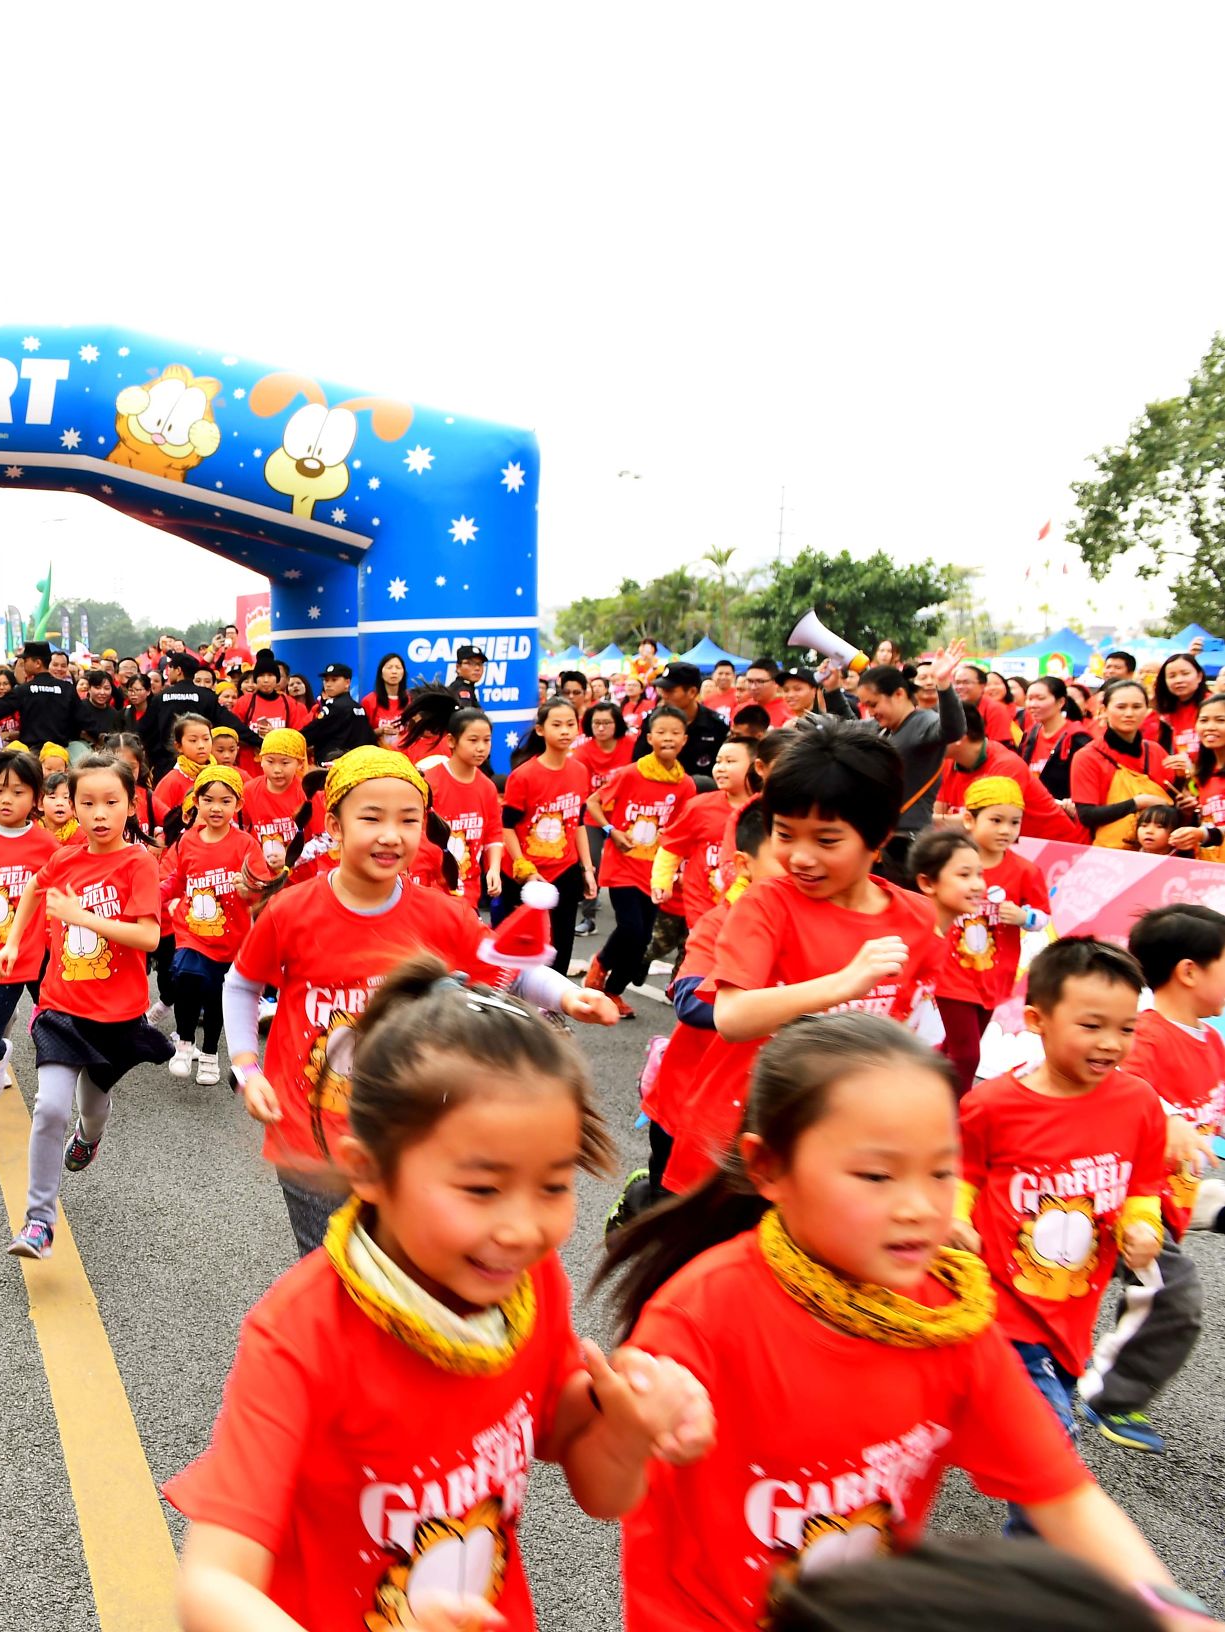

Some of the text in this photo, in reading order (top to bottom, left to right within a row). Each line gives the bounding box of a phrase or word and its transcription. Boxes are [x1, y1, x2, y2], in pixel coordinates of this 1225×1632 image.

[483, 687, 519, 702] TOUR
[9, 883, 26, 897] RU
[93, 900, 121, 918] RUN
